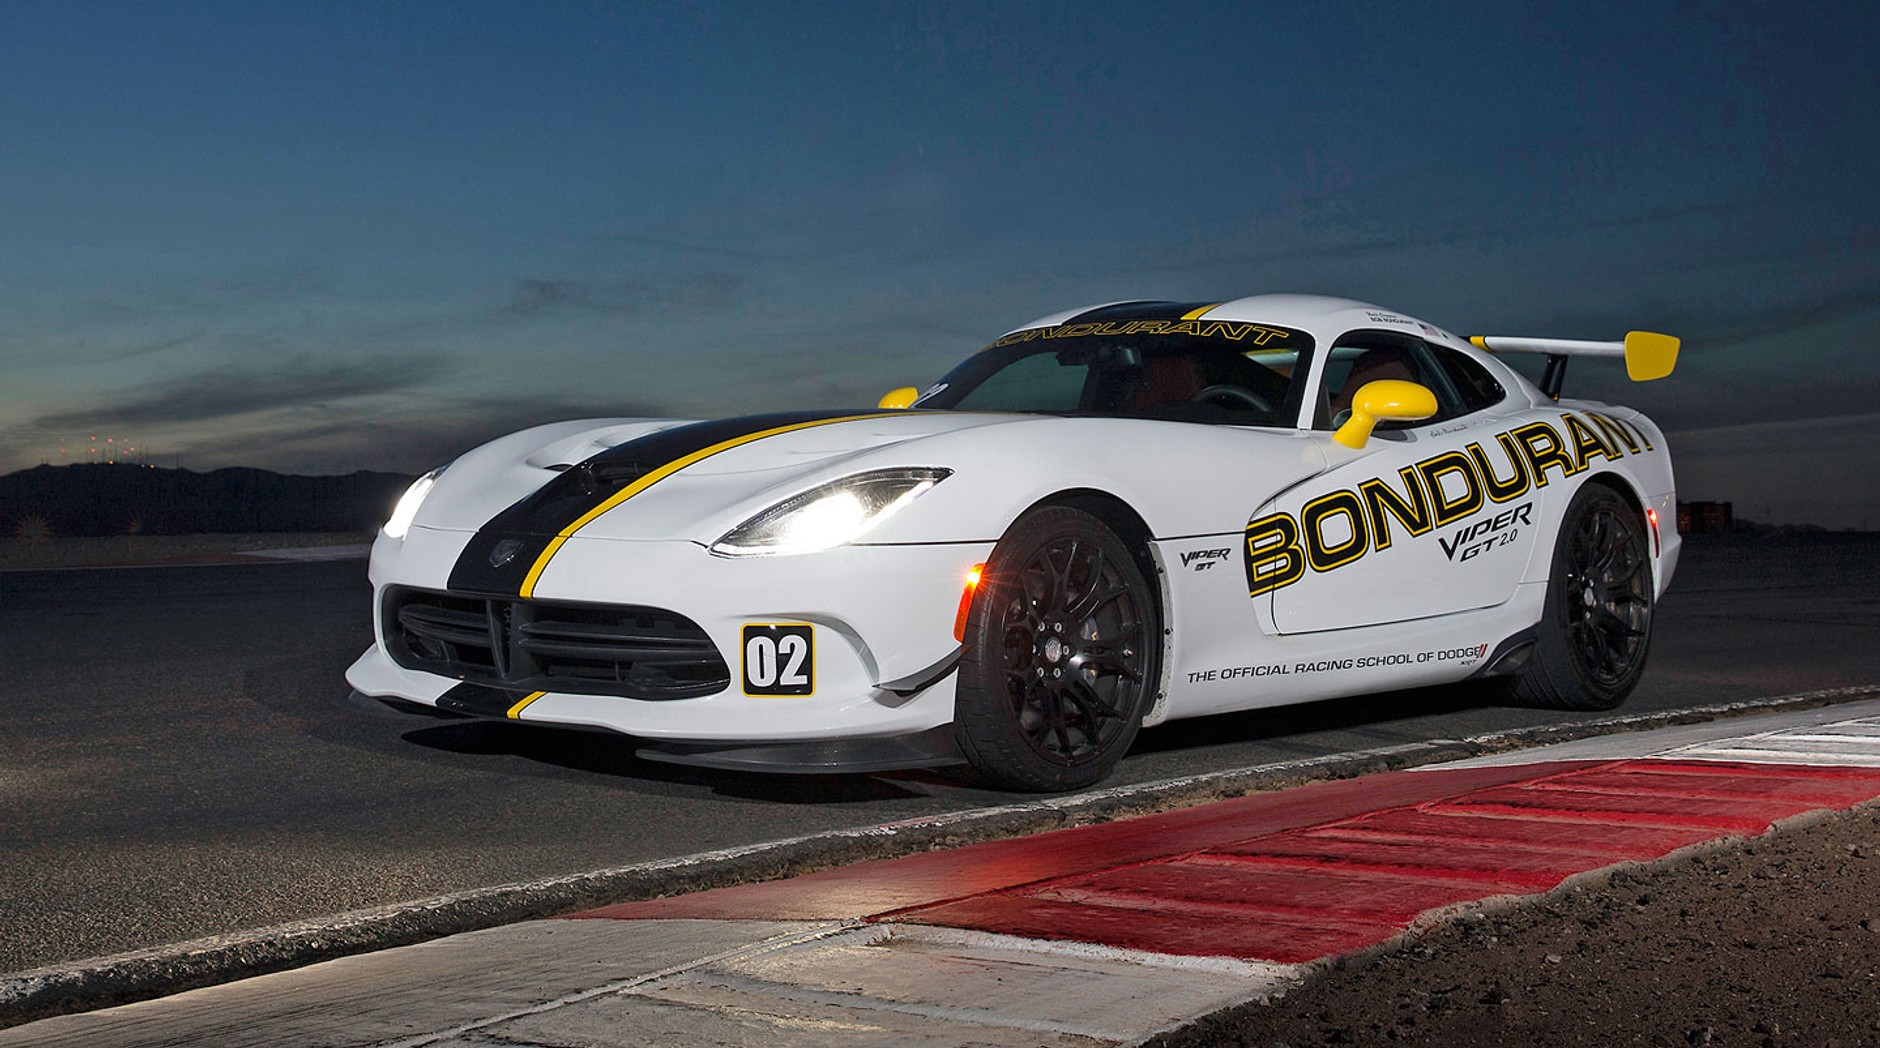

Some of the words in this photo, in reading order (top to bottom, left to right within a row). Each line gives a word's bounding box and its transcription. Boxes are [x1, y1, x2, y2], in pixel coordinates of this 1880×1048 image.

[978, 320, 1289, 350] ONDURANT
[1437, 501, 1533, 563] VIPER
[1460, 535, 1499, 563] GT
[1499, 528, 1519, 547] 2.0
[1180, 548, 1232, 568] VIPER
[746, 634, 808, 688] 02
[1187, 669, 1217, 684] THE
[1220, 664, 1290, 680] OFFICIAL
[1294, 658, 1353, 674] RACING
[1356, 654, 1414, 669] SCHOOL
[1416, 651, 1434, 663] OF
[1438, 645, 1480, 661] DODGE
